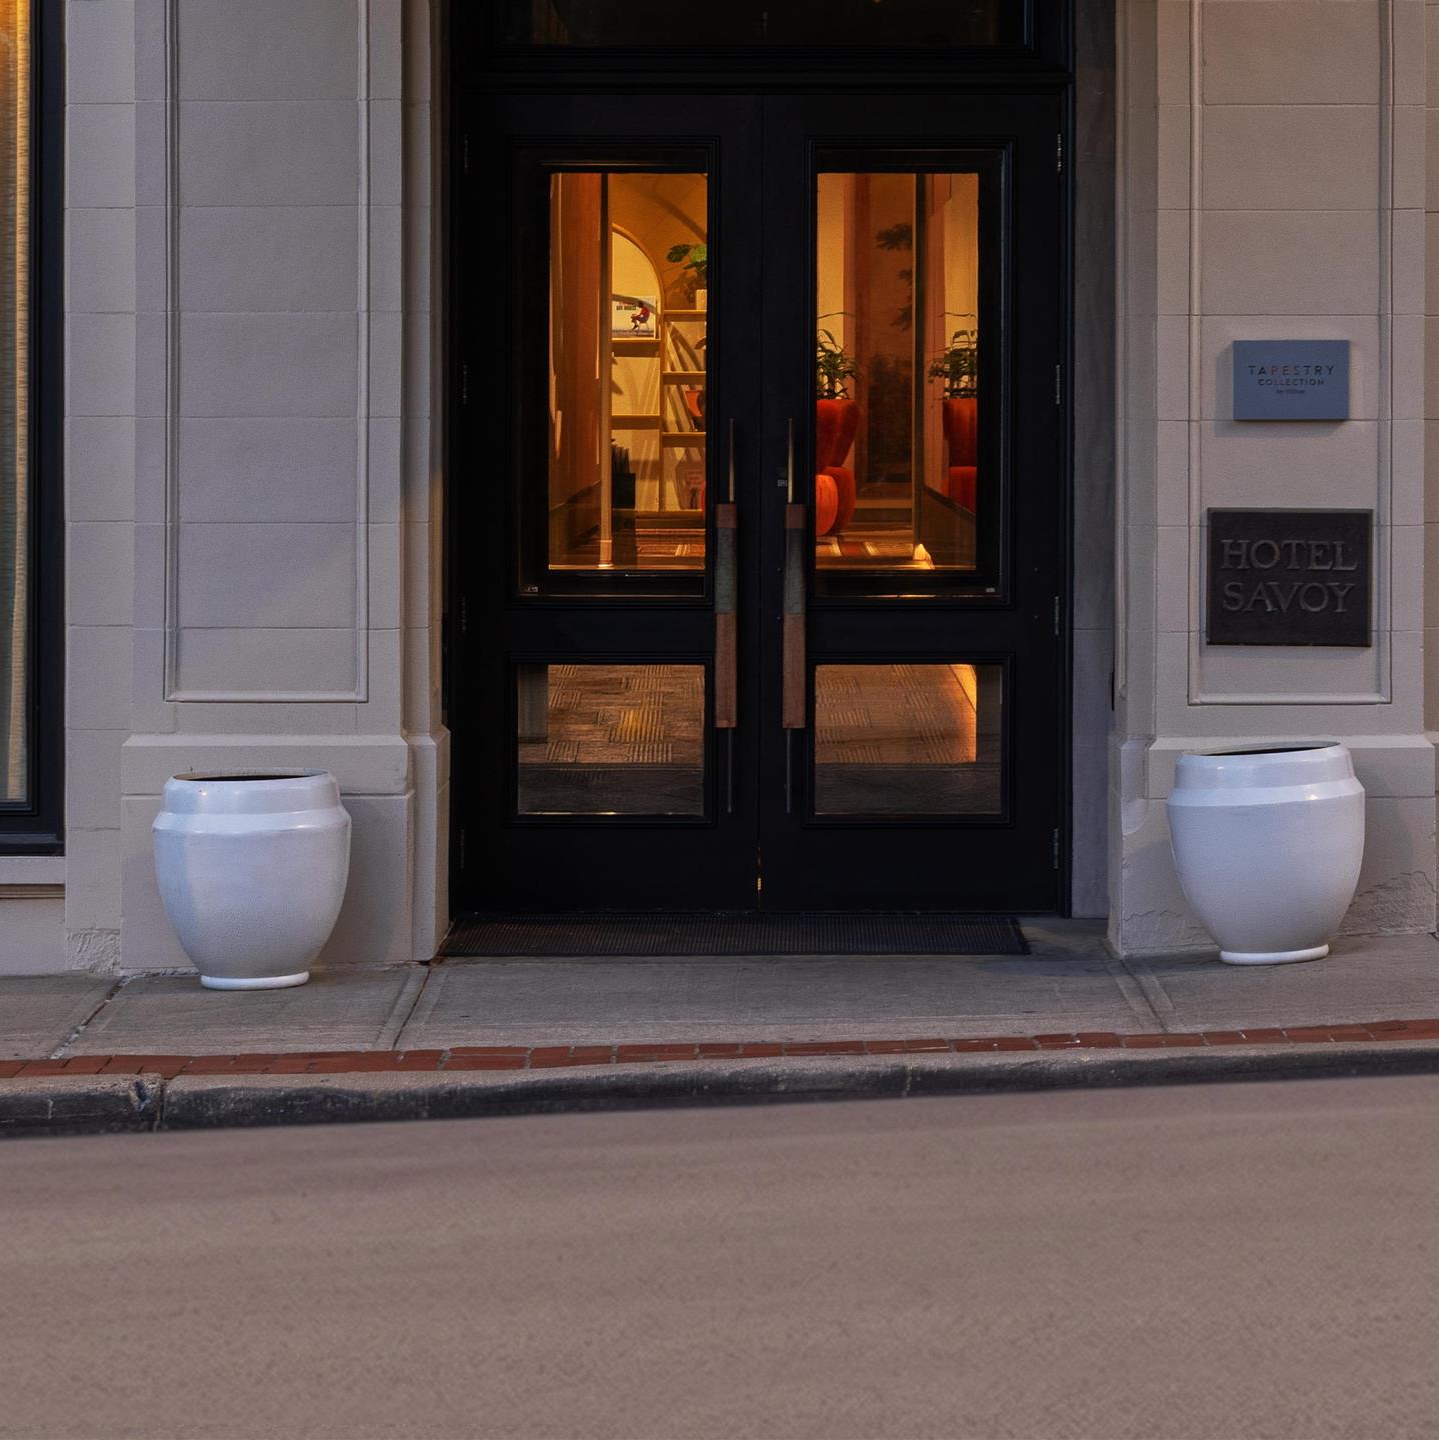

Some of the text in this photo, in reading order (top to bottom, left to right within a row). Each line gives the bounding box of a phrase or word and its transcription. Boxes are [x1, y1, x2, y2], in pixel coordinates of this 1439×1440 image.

[1248, 365, 1335, 376] TAPESTRY
[1257, 378, 1325, 386] COLLECTION
[1220, 539, 1359, 571] HOTEL
[1222, 581, 1356, 613] SAVOY
